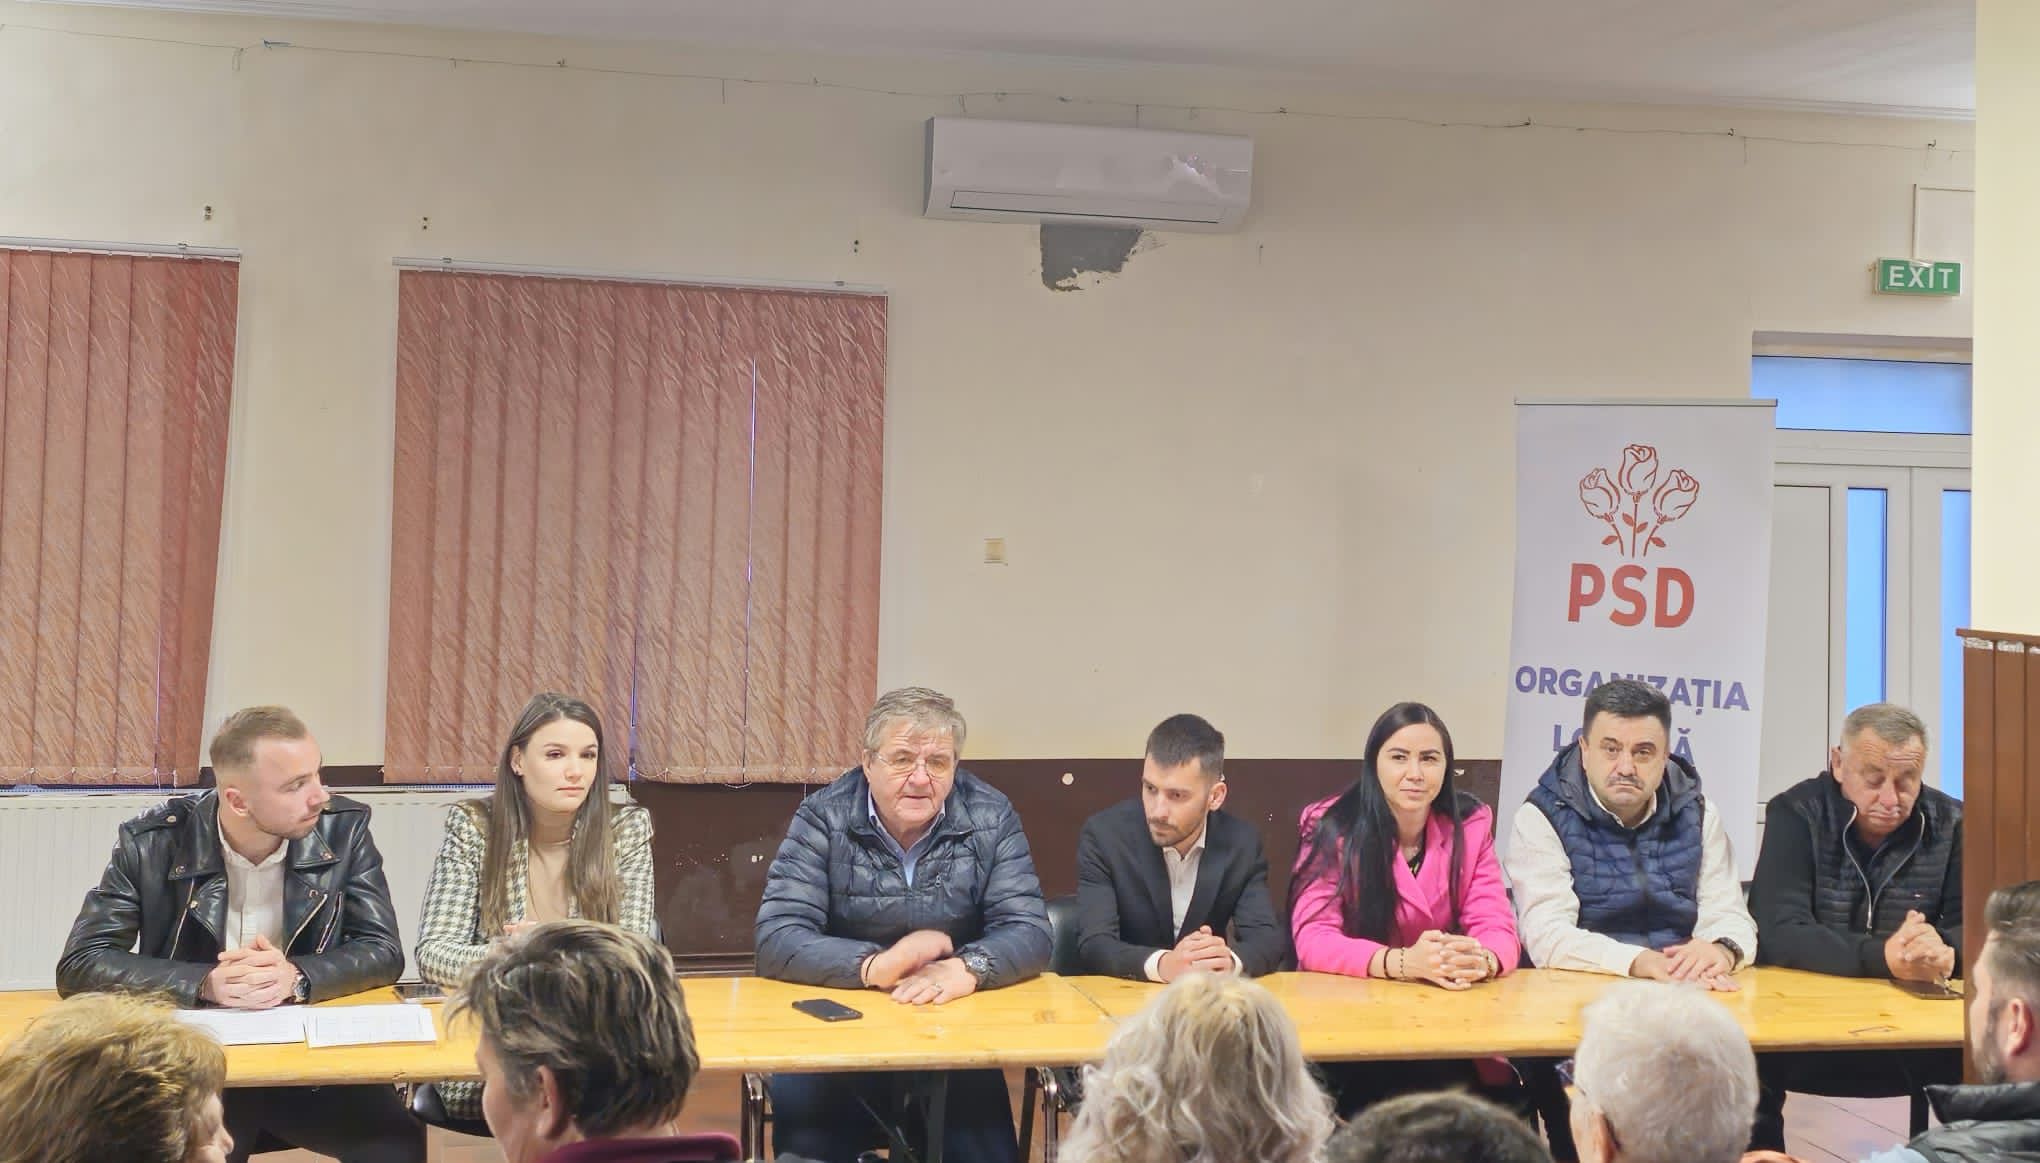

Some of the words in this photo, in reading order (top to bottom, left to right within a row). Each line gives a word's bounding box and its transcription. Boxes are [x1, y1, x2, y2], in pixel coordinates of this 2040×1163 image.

[1888, 265, 1954, 289] EXIT
[1568, 563, 1695, 628] PSD
[1515, 665, 1750, 715] ORGAZAȚIA
